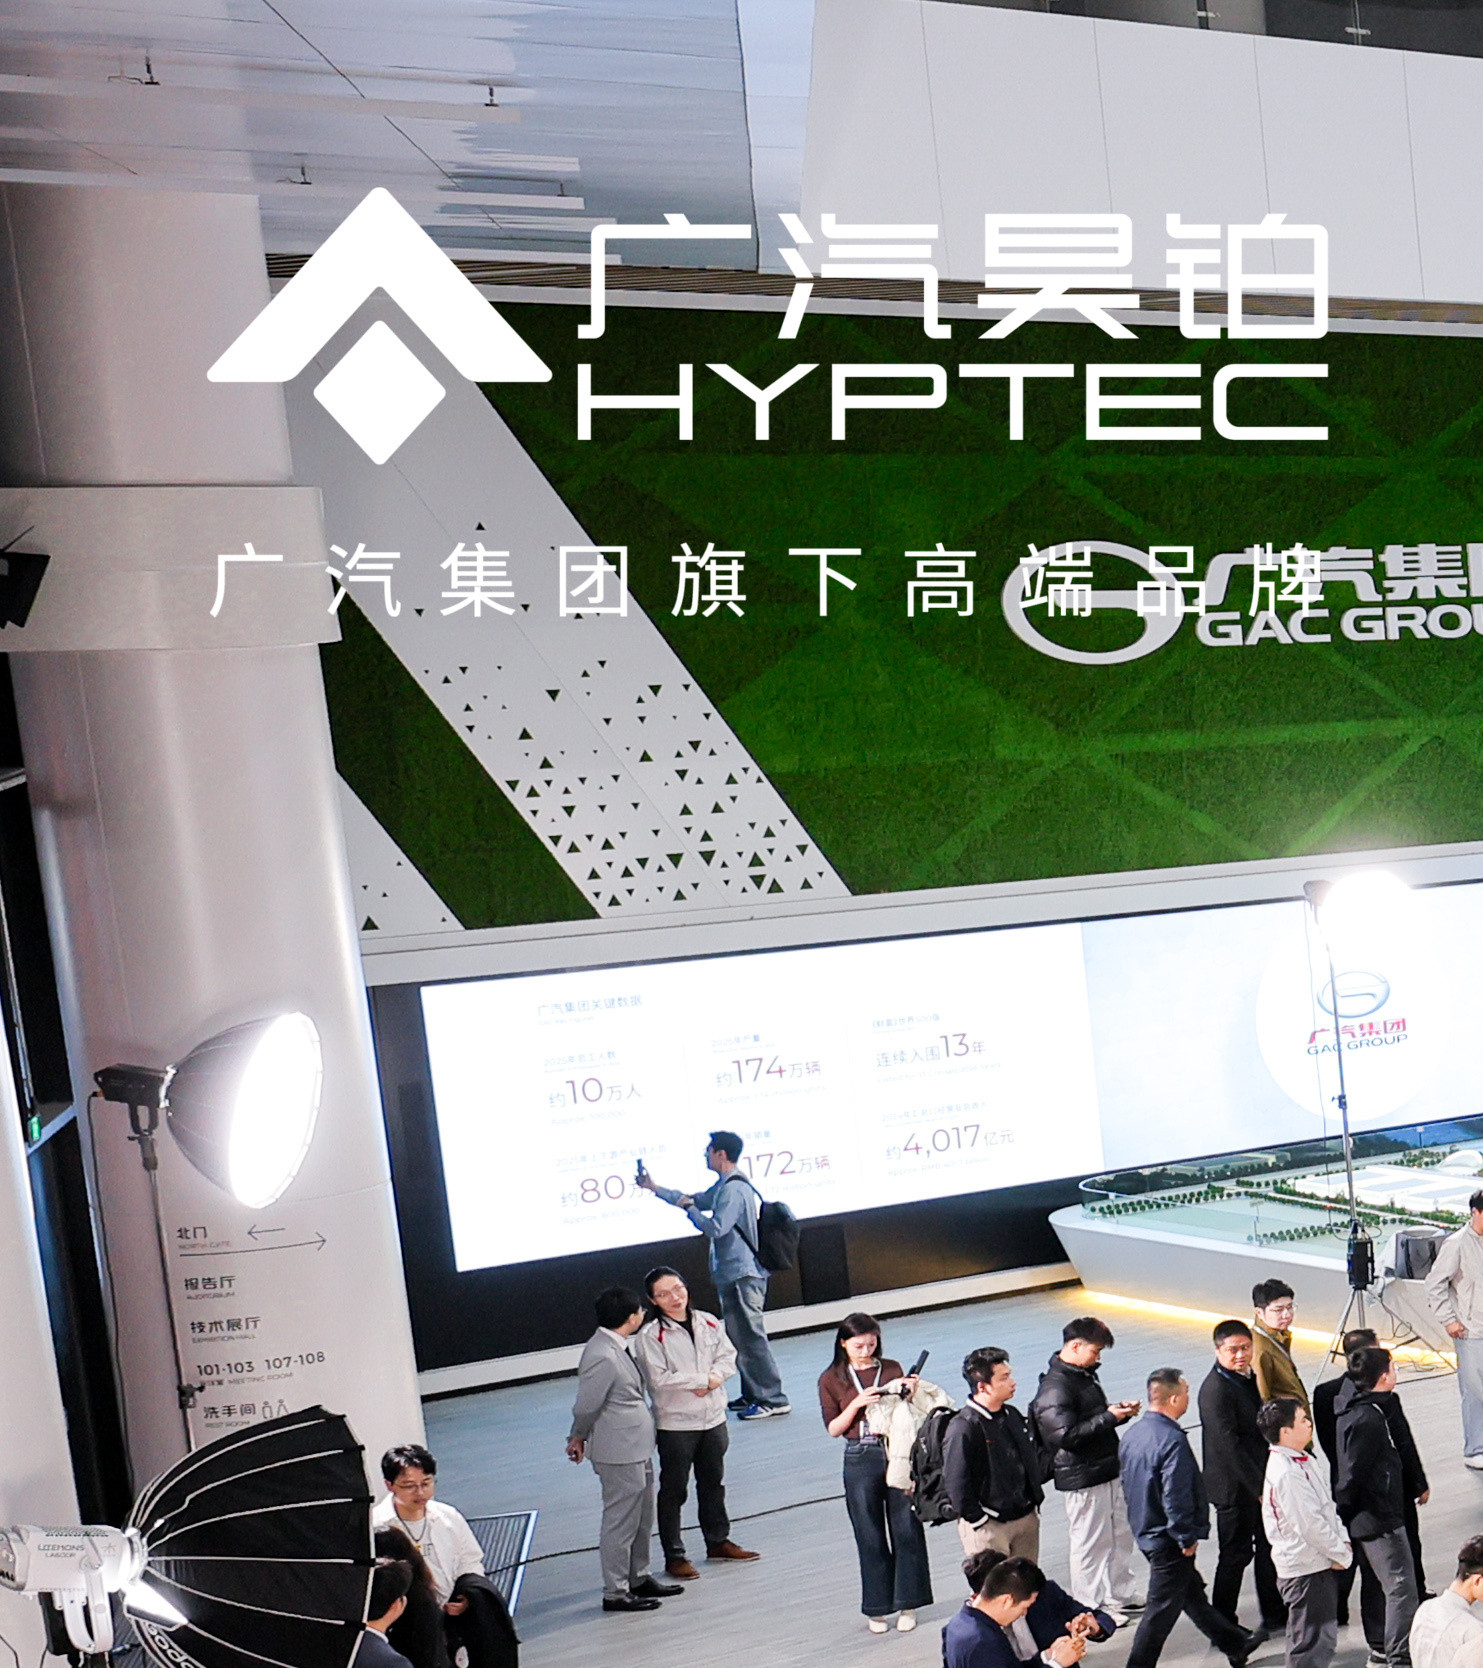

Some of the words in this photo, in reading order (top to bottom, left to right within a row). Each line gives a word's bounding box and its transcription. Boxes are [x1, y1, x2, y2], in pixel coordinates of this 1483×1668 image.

[1196, 608, 1332, 648] GAC
[537, 994, 643, 1017] 广汽集团关键数据
[1306, 1018, 1407, 1045] 广汽集团
[1346, 1033, 1409, 1051] GROUP
[876, 1033, 987, 1069] 连续入围13年
[716, 1055, 822, 1088] 约174万辆
[548, 1077, 642, 1109] 约10万人
[885, 1123, 1016, 1161] 约4,017亿元
[742, 1150, 831, 1180] 172万辆
[176, 1226, 208, 1240] 北门
[183, 1275, 236, 1291] 报告厅
[189, 1316, 262, 1335] 技术展厅
[196, 1360, 256, 1377] 101-103
[264, 1351, 326, 1371] 107-108
[203, 1403, 257, 1420] 洗手间
